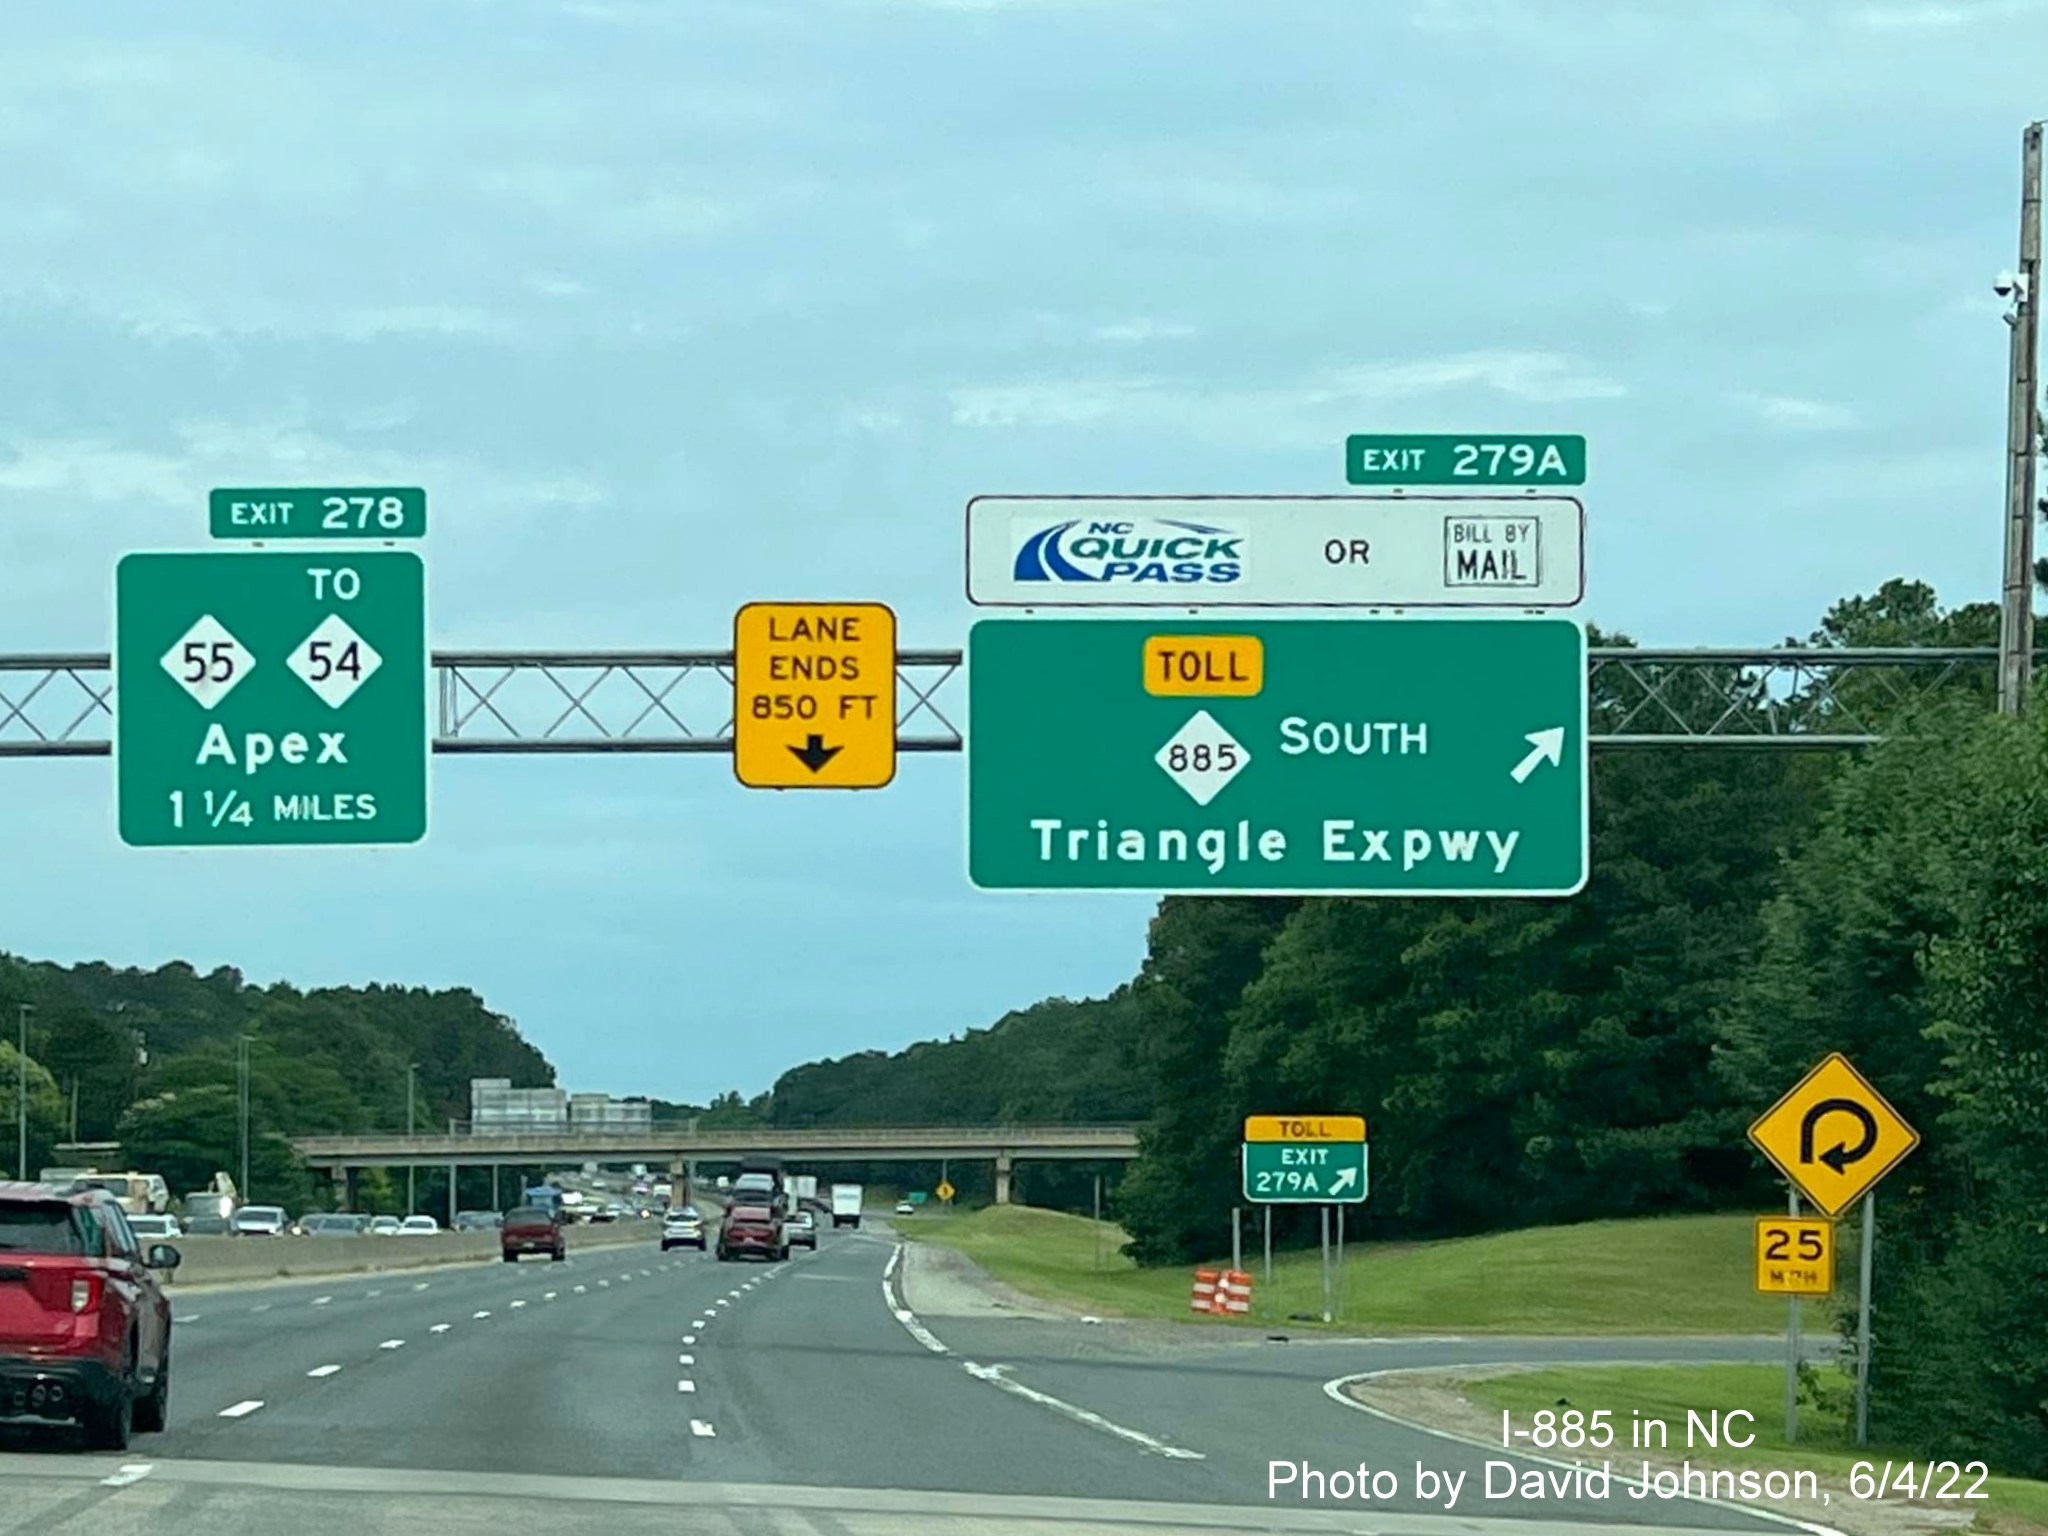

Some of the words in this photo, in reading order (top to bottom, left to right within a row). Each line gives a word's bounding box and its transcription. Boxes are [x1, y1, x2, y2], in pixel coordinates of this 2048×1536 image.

[1363, 449, 1426, 472] EXIT
[1453, 444, 1568, 477] 279A
[231, 502, 293, 525] EXIT
[322, 497, 405, 529] 278
[1088, 522, 1134, 534] NC
[1453, 523, 1493, 543] BILL
[1505, 523, 1530, 543] BY
[1069, 537, 1244, 560] QUICK
[1325, 540, 1370, 566] OR
[1100, 562, 1241, 583] PASS
[1457, 549, 1527, 580] MAIL
[307, 568, 360, 600] TO
[769, 616, 861, 642] LANE
[183, 642, 235, 683] 55
[308, 641, 362, 681] 54
[770, 655, 860, 681] ENDS
[1158, 650, 1250, 682] TOLL
[752, 694, 817, 720] 850
[839, 694, 878, 720] FT
[196, 723, 348, 775] Apex
[1279, 717, 1428, 755] SOUTH
[1168, 743, 1238, 772] 885
[169, 790, 184, 828] 1
[273, 794, 377, 821] MILES
[1030, 819, 1287, 875] Triangle
[1323, 819, 1520, 873] Expwy
[1279, 1121, 1332, 1137] TOLL
[1281, 1148, 1329, 1165] EXIT
[1256, 1171, 1319, 1192] 279A
[1765, 1229, 1823, 1261] 25
